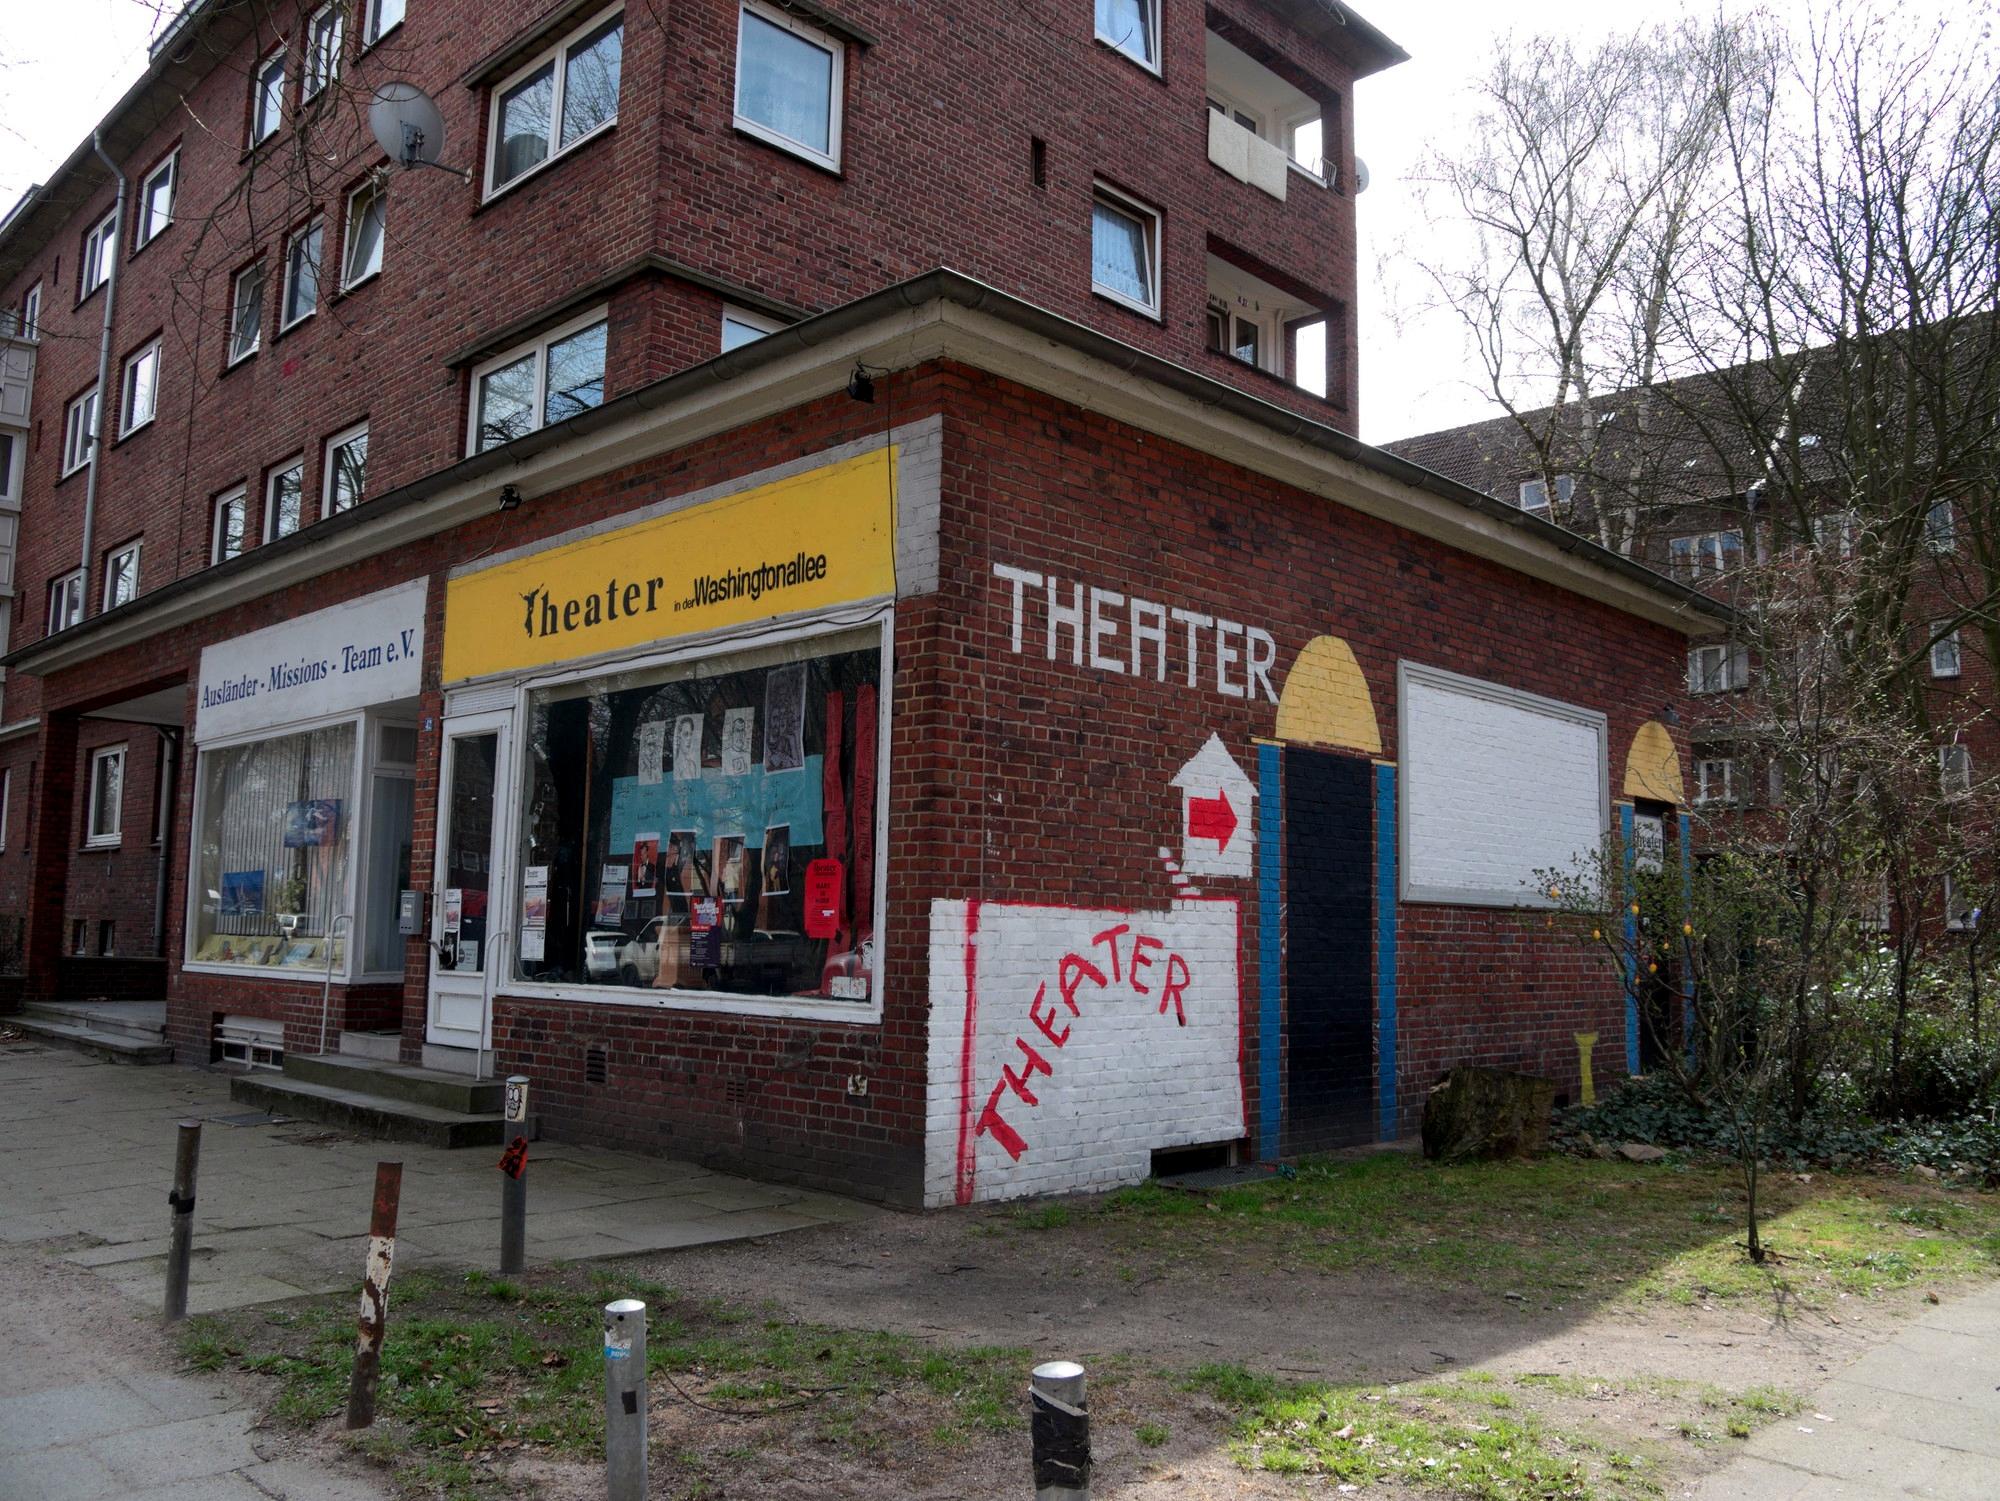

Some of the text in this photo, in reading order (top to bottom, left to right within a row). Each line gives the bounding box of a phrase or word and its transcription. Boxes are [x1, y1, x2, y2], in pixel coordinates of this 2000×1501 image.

[520, 551, 827, 638] Theater in der Washingtonallee
[993, 563, 1280, 704] THEATER
[201, 674, 258, 709] Ausländer
[268, 658, 327, 693] Missions
[341, 645, 381, 674] Team
[386, 629, 415, 662] e.V.
[976, 923, 1190, 1162] THEATER
